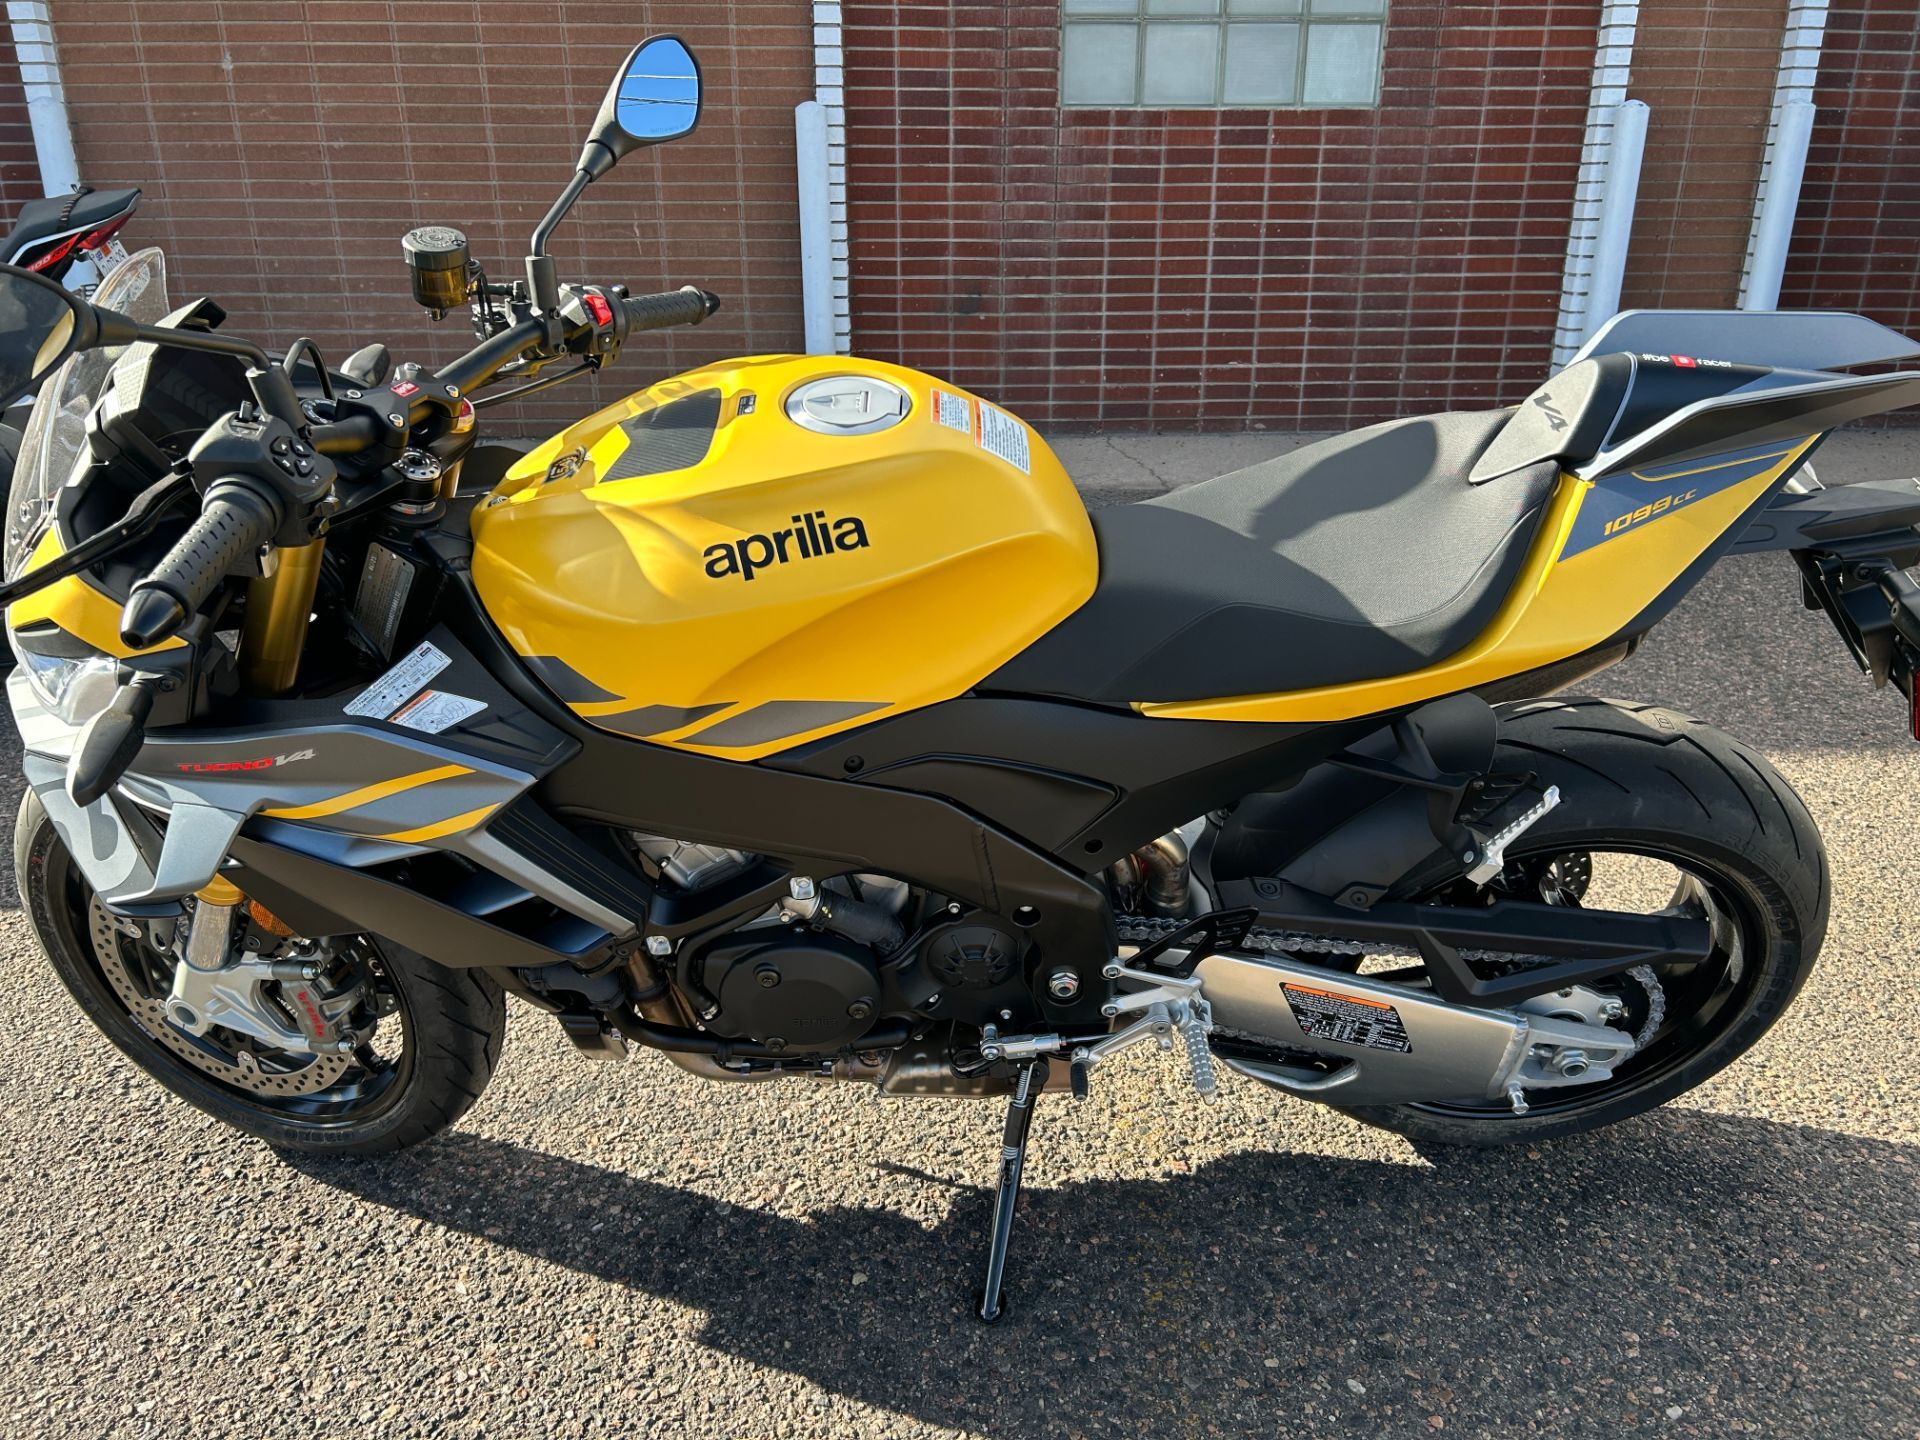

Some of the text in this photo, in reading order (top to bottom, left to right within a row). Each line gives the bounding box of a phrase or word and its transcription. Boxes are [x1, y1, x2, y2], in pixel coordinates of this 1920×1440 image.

[1642, 352, 1670, 364] #be
[1697, 357, 1733, 368] racer
[1532, 391, 1570, 433] V4
[703, 510, 869, 581] aprilia
[177, 748, 317, 772] TUONO V4
[296, 990, 326, 1038] brembo
